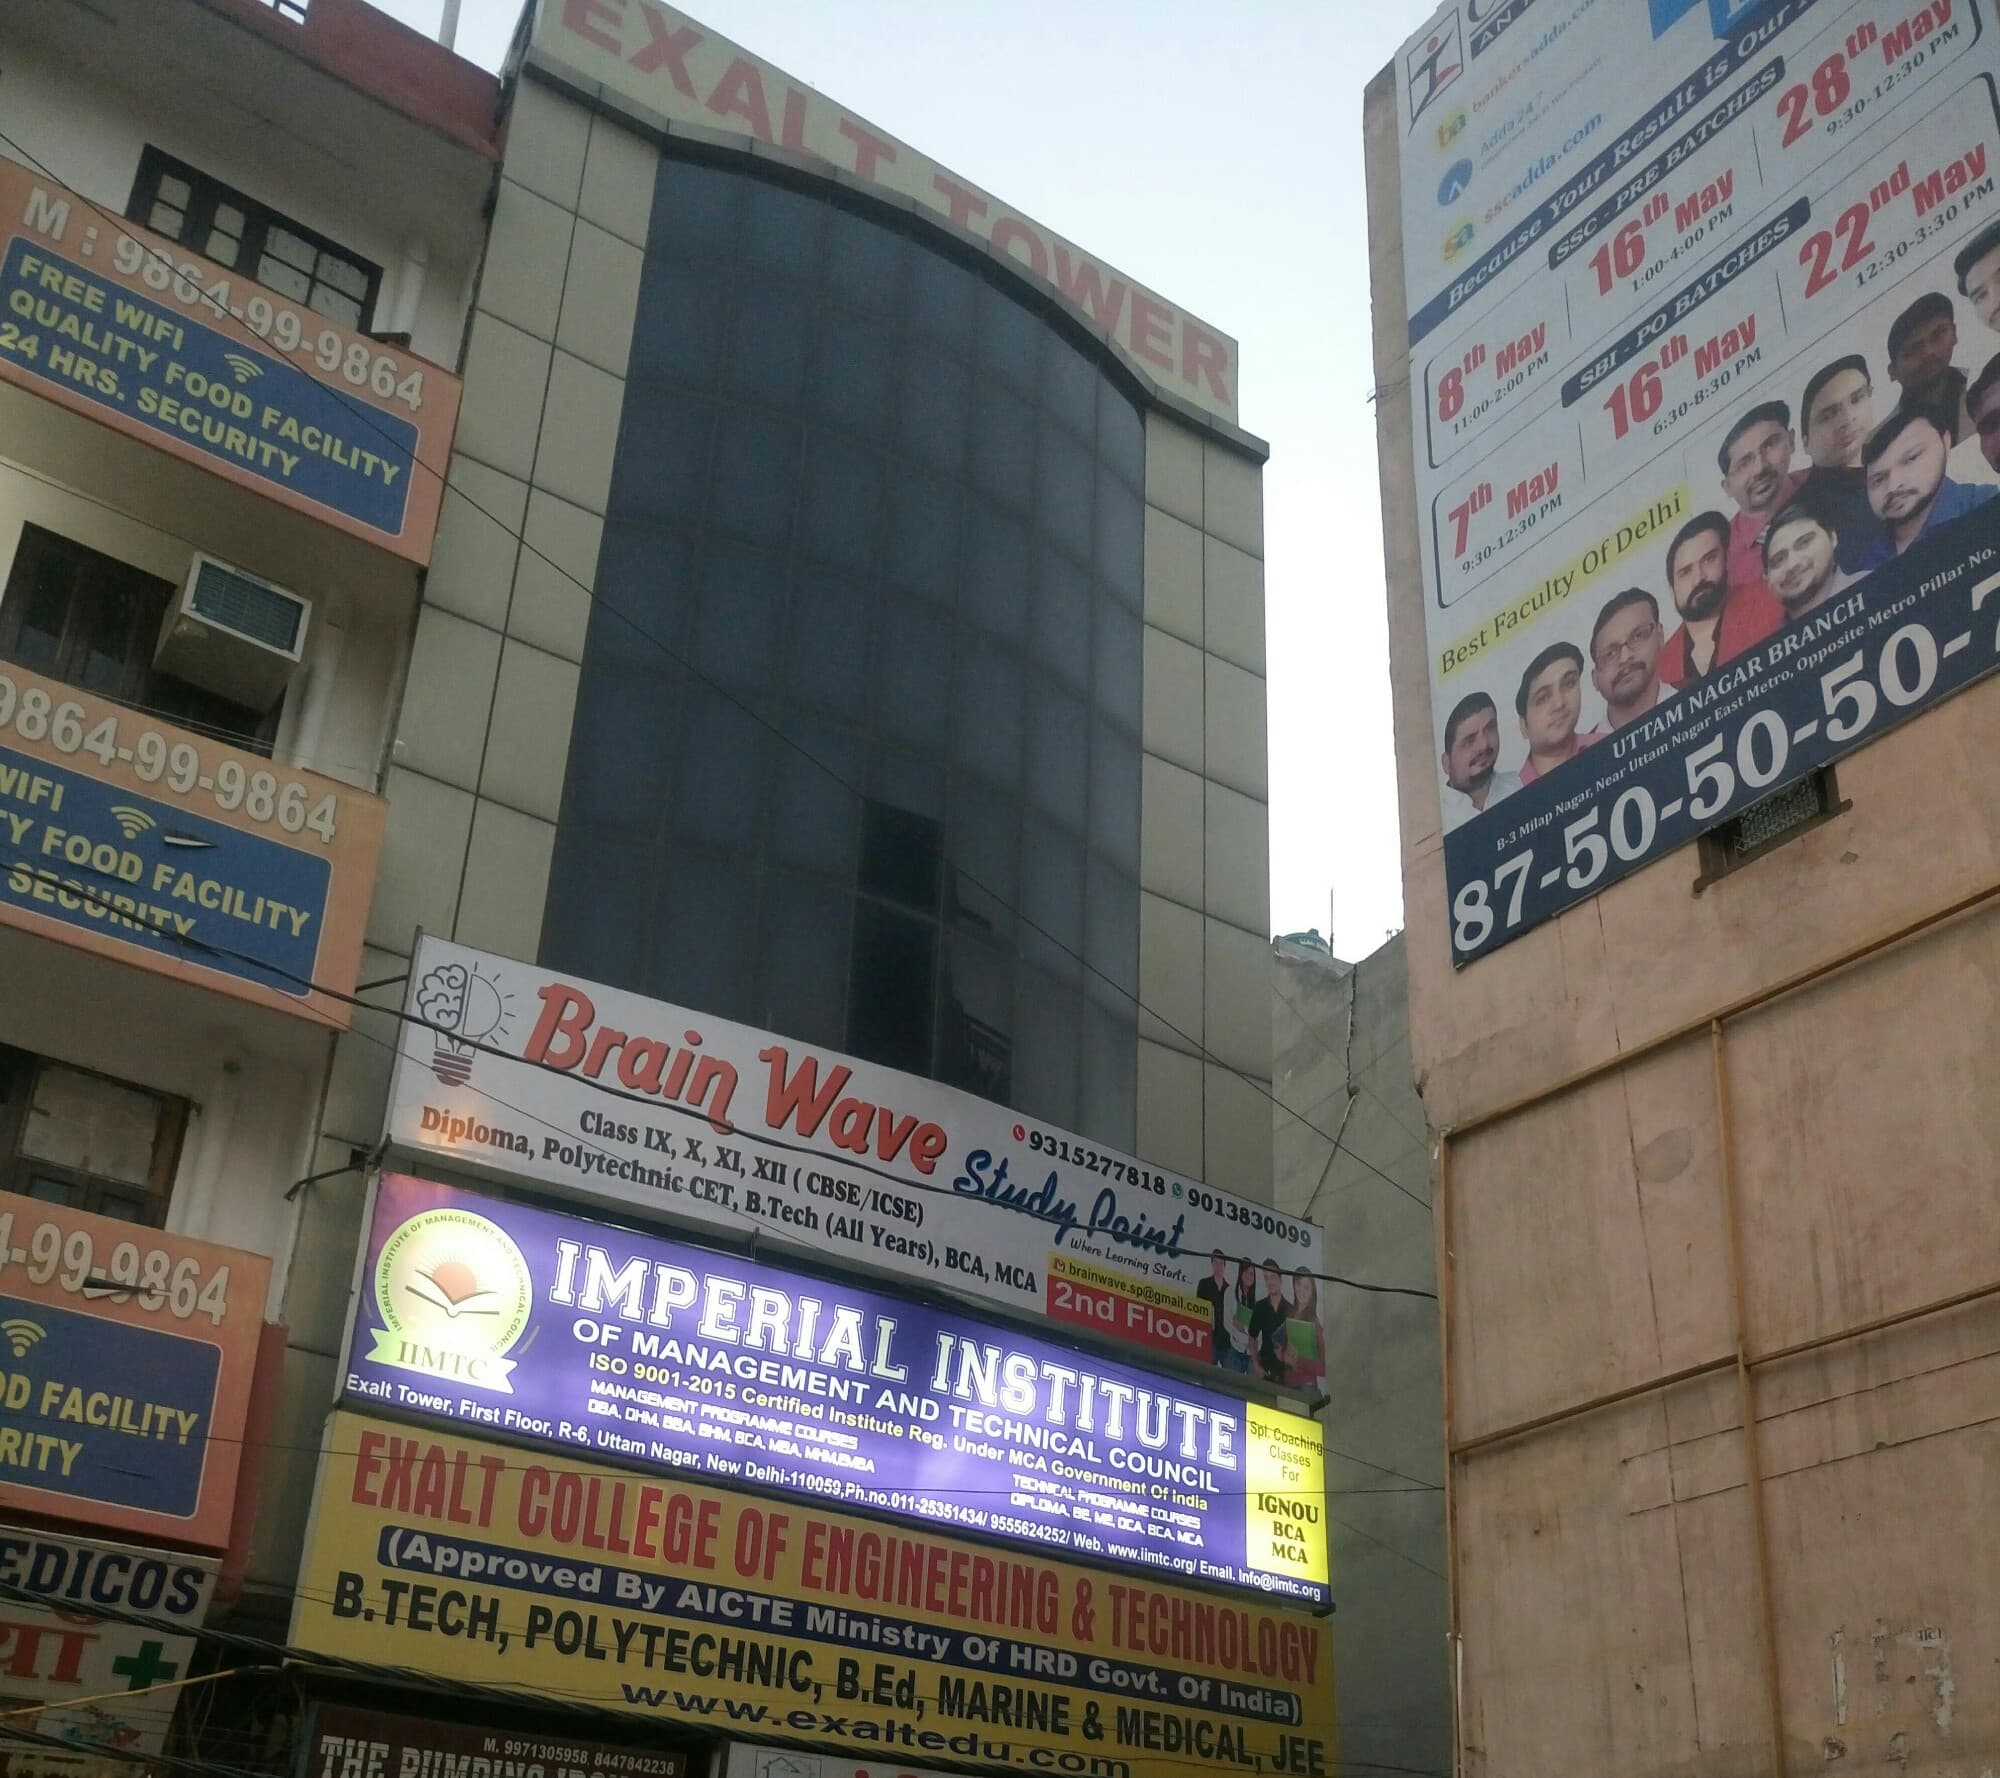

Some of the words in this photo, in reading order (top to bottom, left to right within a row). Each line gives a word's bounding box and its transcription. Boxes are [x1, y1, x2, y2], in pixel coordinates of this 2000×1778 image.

[1776, 20, 1878, 150] 28th
[1881, 0, 1953, 66] May
[1825, 51, 1925, 137] 9:30-12:30
[1930, 22, 1960, 55] PM
[560, 0, 897, 182] EXALT
[932, 173, 1231, 405] TOWER
[1447, 218, 1543, 310] Because
[1549, 164, 1607, 221] Your
[1611, 86, 1698, 168] Result
[1704, 57, 1729, 87] is
[1737, 4, 1790, 57] Our
[1555, 216, 1599, 262] SSC
[1616, 167, 1660, 211] PRE
[1666, 65, 1777, 165] BATCHES
[1588, 191, 1670, 297] 16th
[1674, 167, 1733, 235] May
[1631, 226, 1704, 292] 1:00-4:00
[1709, 203, 1733, 231] PM
[1799, 159, 1911, 300] 22nd
[1911, 141, 1986, 218] May
[1855, 204, 1958, 289] 12:30-3:30
[1962, 176, 1995, 211] PM
[19, 254, 105, 313] FREE
[115, 298, 185, 352] WIFI
[23, 187, 71, 241] M
[113, 232, 425, 413] 9864-99-9864
[1578, 350, 1618, 392] SBI
[1636, 312, 1667, 347] PO
[1674, 216, 1791, 317] BATCHES
[1693, 312, 1757, 381] May
[0, 321, 40, 361] 24
[48, 344, 125, 401] HRS.
[136, 386, 301, 477] SECURITY
[9, 288, 160, 374] QUALITY
[165, 361, 252, 420] FOOD
[261, 406, 400, 486] FACILITY
[1437, 342, 1486, 423] 8th
[1495, 321, 1546, 381] May
[1453, 371, 1524, 436] 11:00-2:00
[1527, 350, 1549, 377] PM
[1653, 369, 1731, 437] 6:30-8:30
[1735, 346, 1762, 377] PM
[1462, 512, 1536, 575] 9:30-12:30
[1540, 494, 1563, 520] PM
[1506, 461, 1559, 520] May
[1440, 626, 1488, 676] Best
[1494, 564, 1577, 638] Faculty
[1581, 533, 1613, 578] Of
[1616, 491, 1681, 552] Delhi
[1519, 806, 1553, 839] Milap
[1596, 767, 1626, 791] Near
[1628, 743, 1669, 772] Uttam
[1672, 716, 1711, 747] Nagar
[1714, 696, 1744, 720] East
[1747, 668, 1794, 702] Metro,
[1796, 627, 1864, 671] Opposite
[1867, 594, 1916, 630] Metro
[1919, 563, 1965, 598] Pillar
[1969, 548, 1997, 569] No.
[1612, 704, 1684, 759] UTTAM
[1689, 655, 1763, 715] NAGAR
[1767, 591, 1865, 666] BRANCH
[0, 675, 338, 845] 9864-99-9864
[8, 862, 197, 937] SECURITY
[41, 825, 144, 883] FOOD
[152, 863, 311, 937] FACILITY
[524, 982, 738, 1135] Brain
[759, 1045, 948, 1176] Wave
[953, 1149, 1078, 1245] Study
[1087, 1188, 1186, 1259] Point
[579, 1109, 640, 1147] Class
[644, 1127, 677, 1163] IX,
[685, 1139, 709, 1170] X,
[715, 1146, 745, 1179] XI,
[752, 1157, 787, 1186] XII
[421, 1104, 536, 1162] Diploma,
[542, 1136, 685, 1194] Polytechnic
[688, 1174, 740, 1213] CET,
[744, 1185, 820, 1231] B.Tech
[824, 1209, 866, 1244] (All
[869, 1222, 941, 1270] Years),
[945, 1245, 990, 1282] BCA,
[994, 1262, 1038, 1293] MCA
[1028, 1129, 1165, 1195] 9315277818
[1188, 1189, 1312, 1248] 9013830099
[1068, 1259, 1210, 1318] brainwave.sp@gmail.com
[1070, 1237, 1102, 1259] Where
[1105, 1248, 1149, 1274] Learning
[549, 1237, 908, 1384] IMPERIAL
[930, 1330, 1239, 1472] INSTITUTE
[1053, 1281, 1115, 1323] 2nd
[1126, 1308, 1208, 1348] Floor
[40, 1382, 199, 1446] FACILITY
[573, 1317, 622, 1347] OF
[632, 1331, 870, 1405] MANAGEMENT
[875, 1388, 939, 1422] AND
[949, 1404, 1101, 1464] TECHNICAL
[1109, 1446, 1220, 1493] COUNCIL
[589, 1352, 628, 1375] ISO
[633, 1363, 736, 1400] 9001-2015
[741, 1387, 824, 1420] Certified
[829, 1402, 903, 1439] Institute
[909, 1424, 948, 1449] Reg.
[953, 1434, 1004, 1463] Under
[1009, 1449, 1046, 1474] MCA
[1051, 1461, 1147, 1497] Government
[1150, 1484, 1169, 1502] Of
[1172, 1492, 1208, 1511] India
[1268, 1440, 1311, 1467] Classes
[1273, 1424, 1323, 1457] Coaching
[347, 1373, 392, 1399] Exalt
[398, 1384, 453, 1416] Tower,
[459, 1399, 500, 1424] First
[504, 1409, 553, 1438] Floor,
[559, 1421, 591, 1446] R-6,
[597, 1429, 646, 1456] Uttam
[651, 1441, 701, 1470] Nagar,
[706, 1453, 741, 1474] New
[1199, 1561, 1236, 1581] Email.
[1257, 1493, 1319, 1524] IGNOU
[1281, 1460, 1300, 1483] For
[352, 1430, 505, 1530] EXALT
[517, 1465, 721, 1571] COLLEGE
[734, 1507, 790, 1582] OF
[801, 1519, 1060, 1636] ENGINEERING
[1070, 1577, 1097, 1643] &
[1108, 1583, 1320, 1686] TECHNOLOGY
[1271, 1542, 1309, 1565] MCA
[1273, 1520, 1306, 1543] BCA
[331, 1571, 510, 1656] B.TECH,
[525, 1604, 822, 1704] POLYTECHNIC,
[836, 1656, 926, 1720] B.Ed,
[937, 1673, 1071, 1736] MARINE
[1081, 1700, 1106, 1742] &
[1115, 1704, 1265, 1772] MEDICAL,
[1272, 1733, 1324, 1776] JEE
[387, 1528, 603, 1595] (Approved
[616, 1571, 666, 1609] By
[676, 1582, 796, 1628] AICTE
[806, 1606, 953, 1661] Ministry
[962, 1634, 1001, 1668] Of
[1008, 1639, 1079, 1678] HRD
[1088, 1659, 1170, 1698] Govt.
[1177, 1674, 1213, 1705] Of
[1219, 1684, 1301, 1725] India)
[483, 1737, 499, 1753] M.
[594, 1751, 674, 1776] 8447842238
[621, 1683, 1131, 1778] www.exaltedu.com
